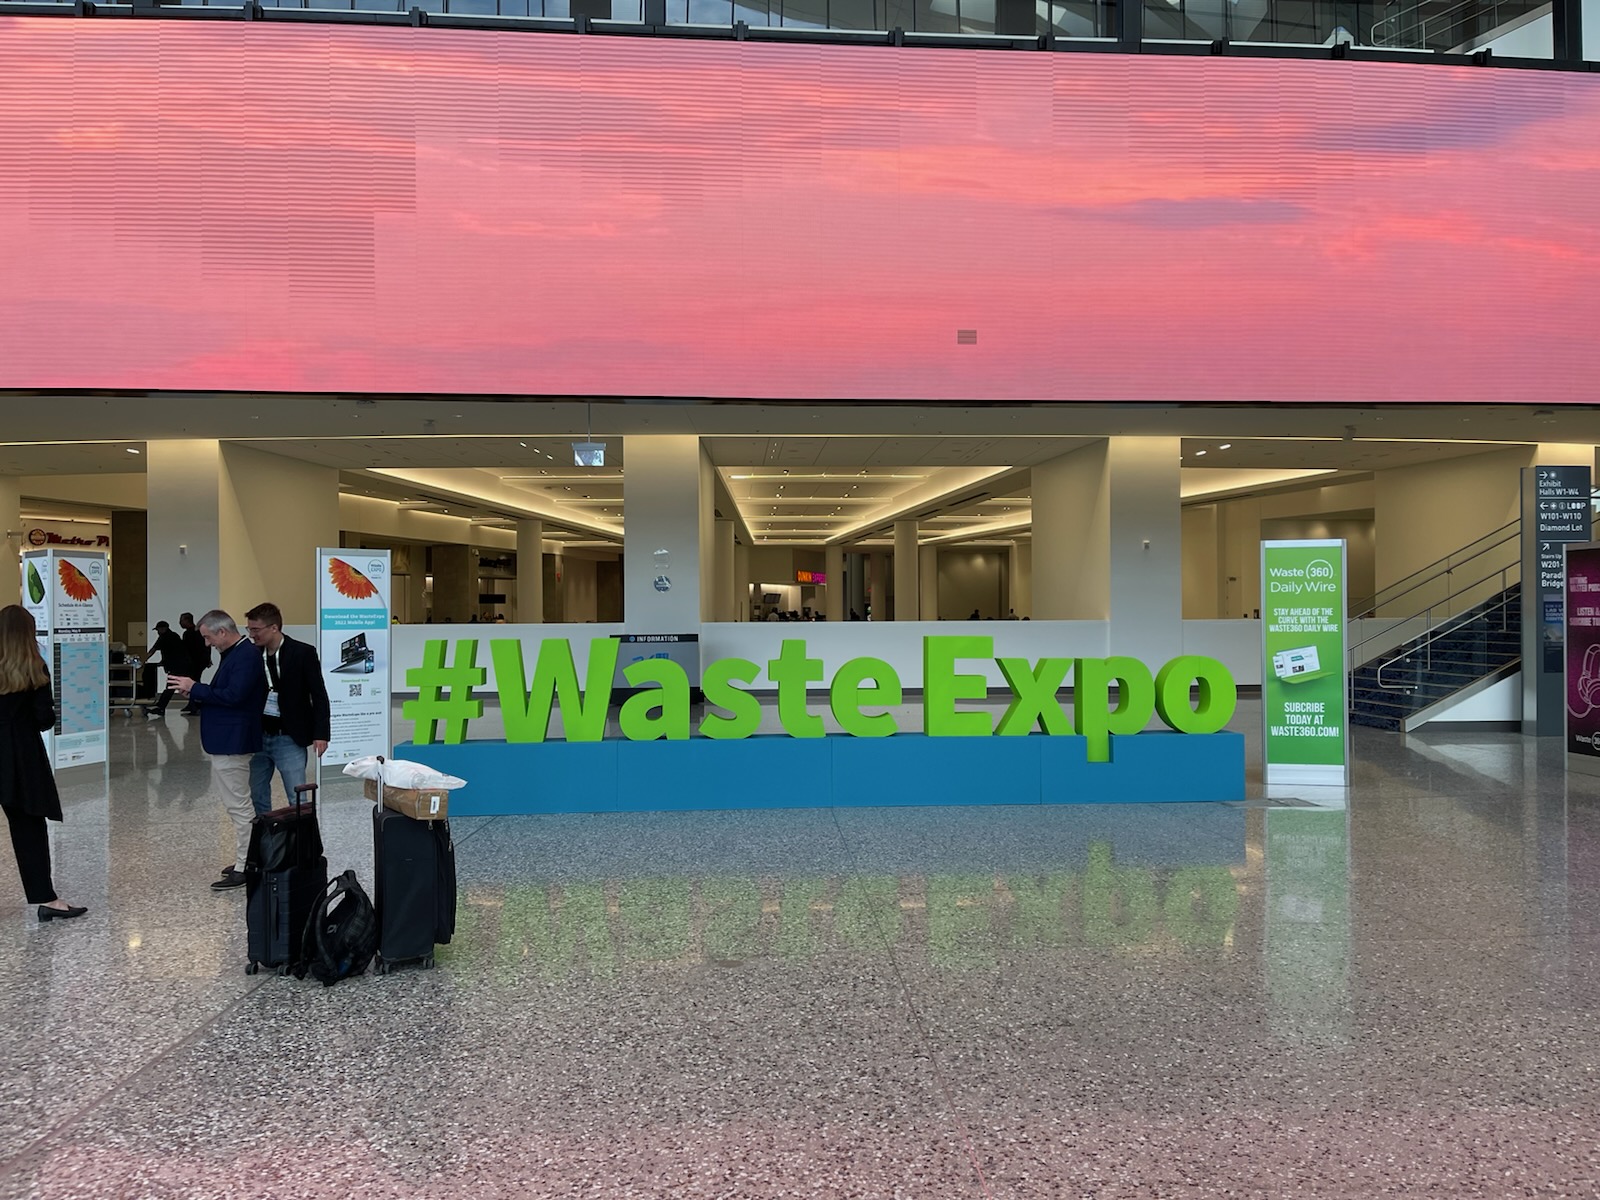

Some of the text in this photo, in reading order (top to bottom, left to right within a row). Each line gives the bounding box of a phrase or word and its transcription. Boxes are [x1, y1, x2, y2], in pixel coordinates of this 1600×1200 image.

[1540, 512, 1582, 520] W101-W110
[46, 532, 96, 546] Metro
[1269, 567, 1329, 577] Waste 360
[1270, 581, 1336, 595] Daily Wire
[1273, 608, 1334, 616] STAY AHEAD OF THE
[1278, 616, 1329, 624] CURVE WITH THE
[1269, 624, 1339, 632] WASTE360 DAILY WIRE
[1284, 702, 1325, 713] SUBCRIBE
[1285, 714, 1324, 725] TODAY AT
[1270, 726, 1339, 737] WASTE360.COM!
